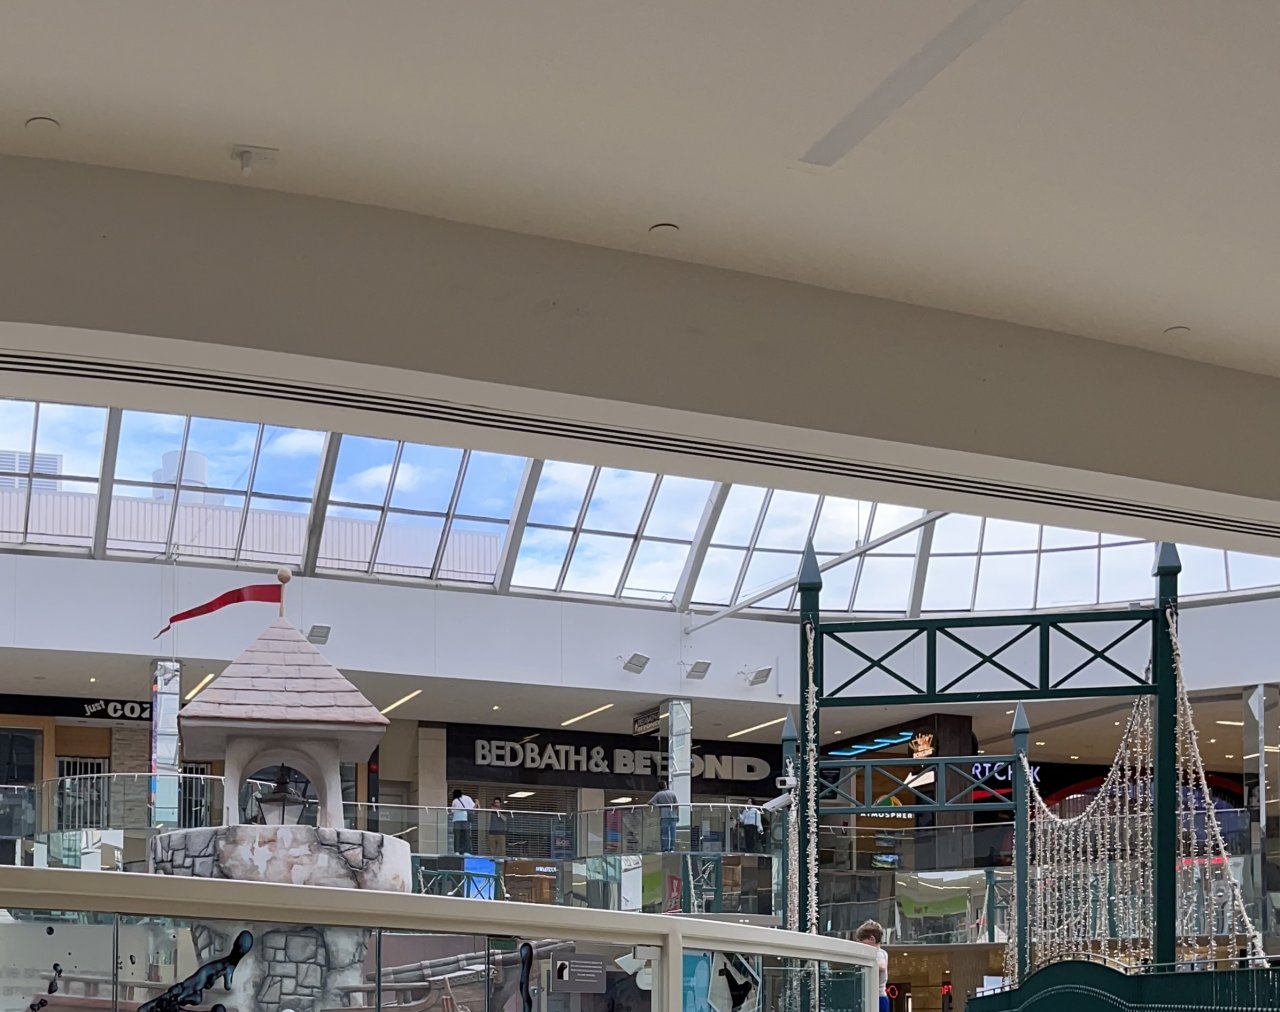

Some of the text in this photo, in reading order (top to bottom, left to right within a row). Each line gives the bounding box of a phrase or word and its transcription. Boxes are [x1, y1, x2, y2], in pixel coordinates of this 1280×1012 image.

[84, 699, 105, 717] just
[474, 739, 524, 767] BED
[524, 743, 588, 773] BATH
[588, 746, 610, 774] &
